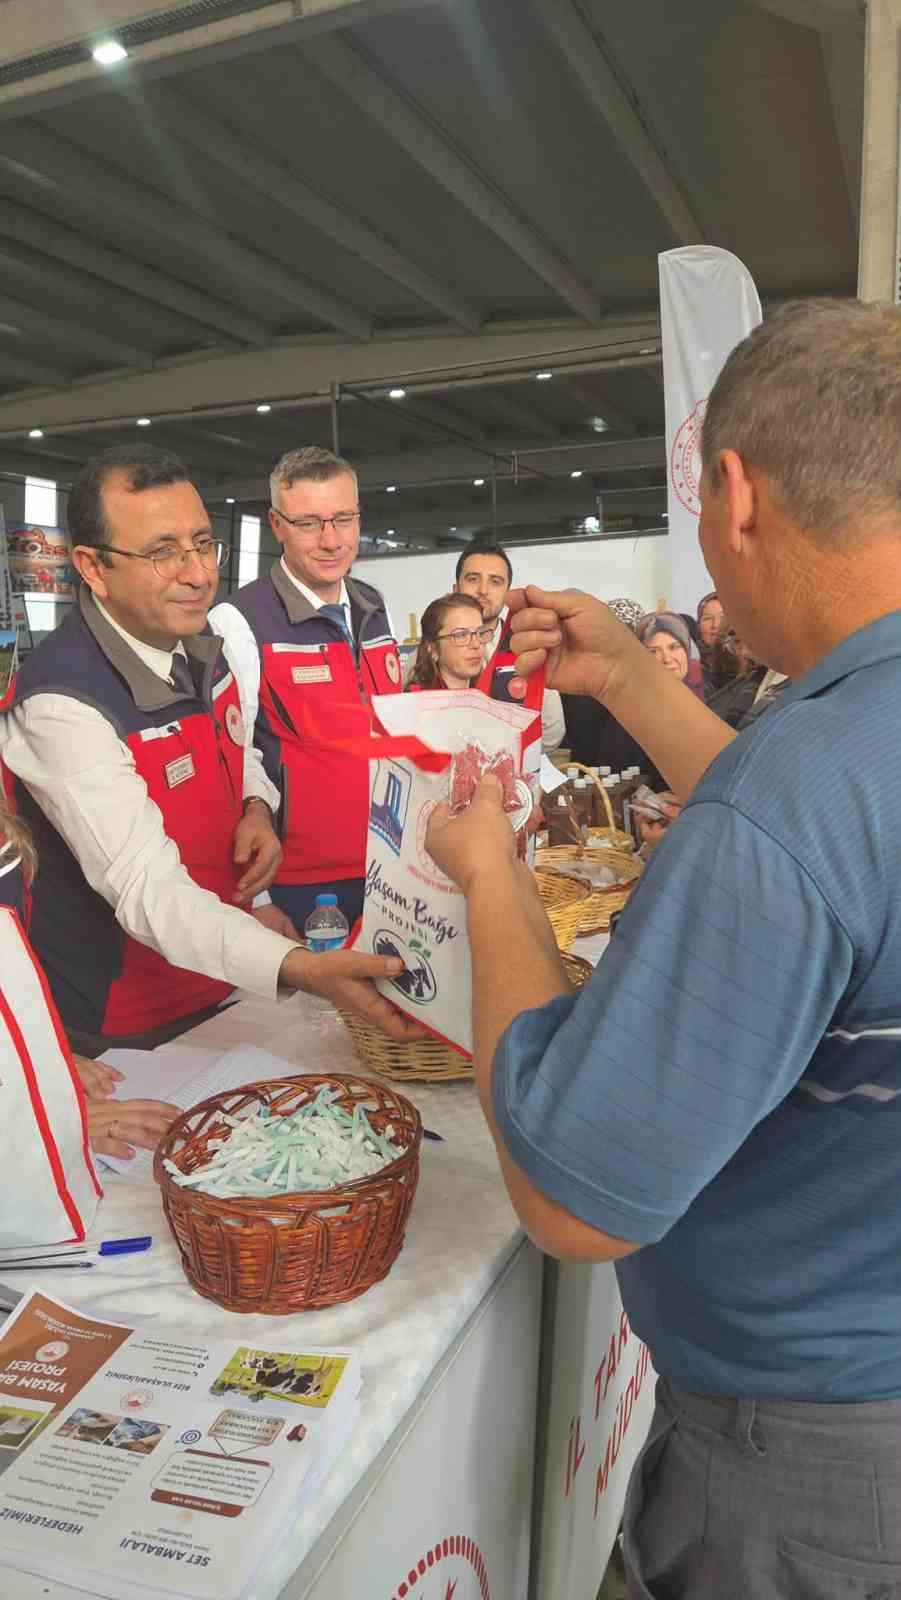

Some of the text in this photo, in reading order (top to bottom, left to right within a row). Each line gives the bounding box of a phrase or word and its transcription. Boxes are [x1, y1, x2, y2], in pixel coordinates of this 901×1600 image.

[366, 859, 412, 911] Yaşam
[413, 897, 459, 944] Bağı
[565, 1416, 586, 1497] İL
[185, 1551, 211, 1567] SET
